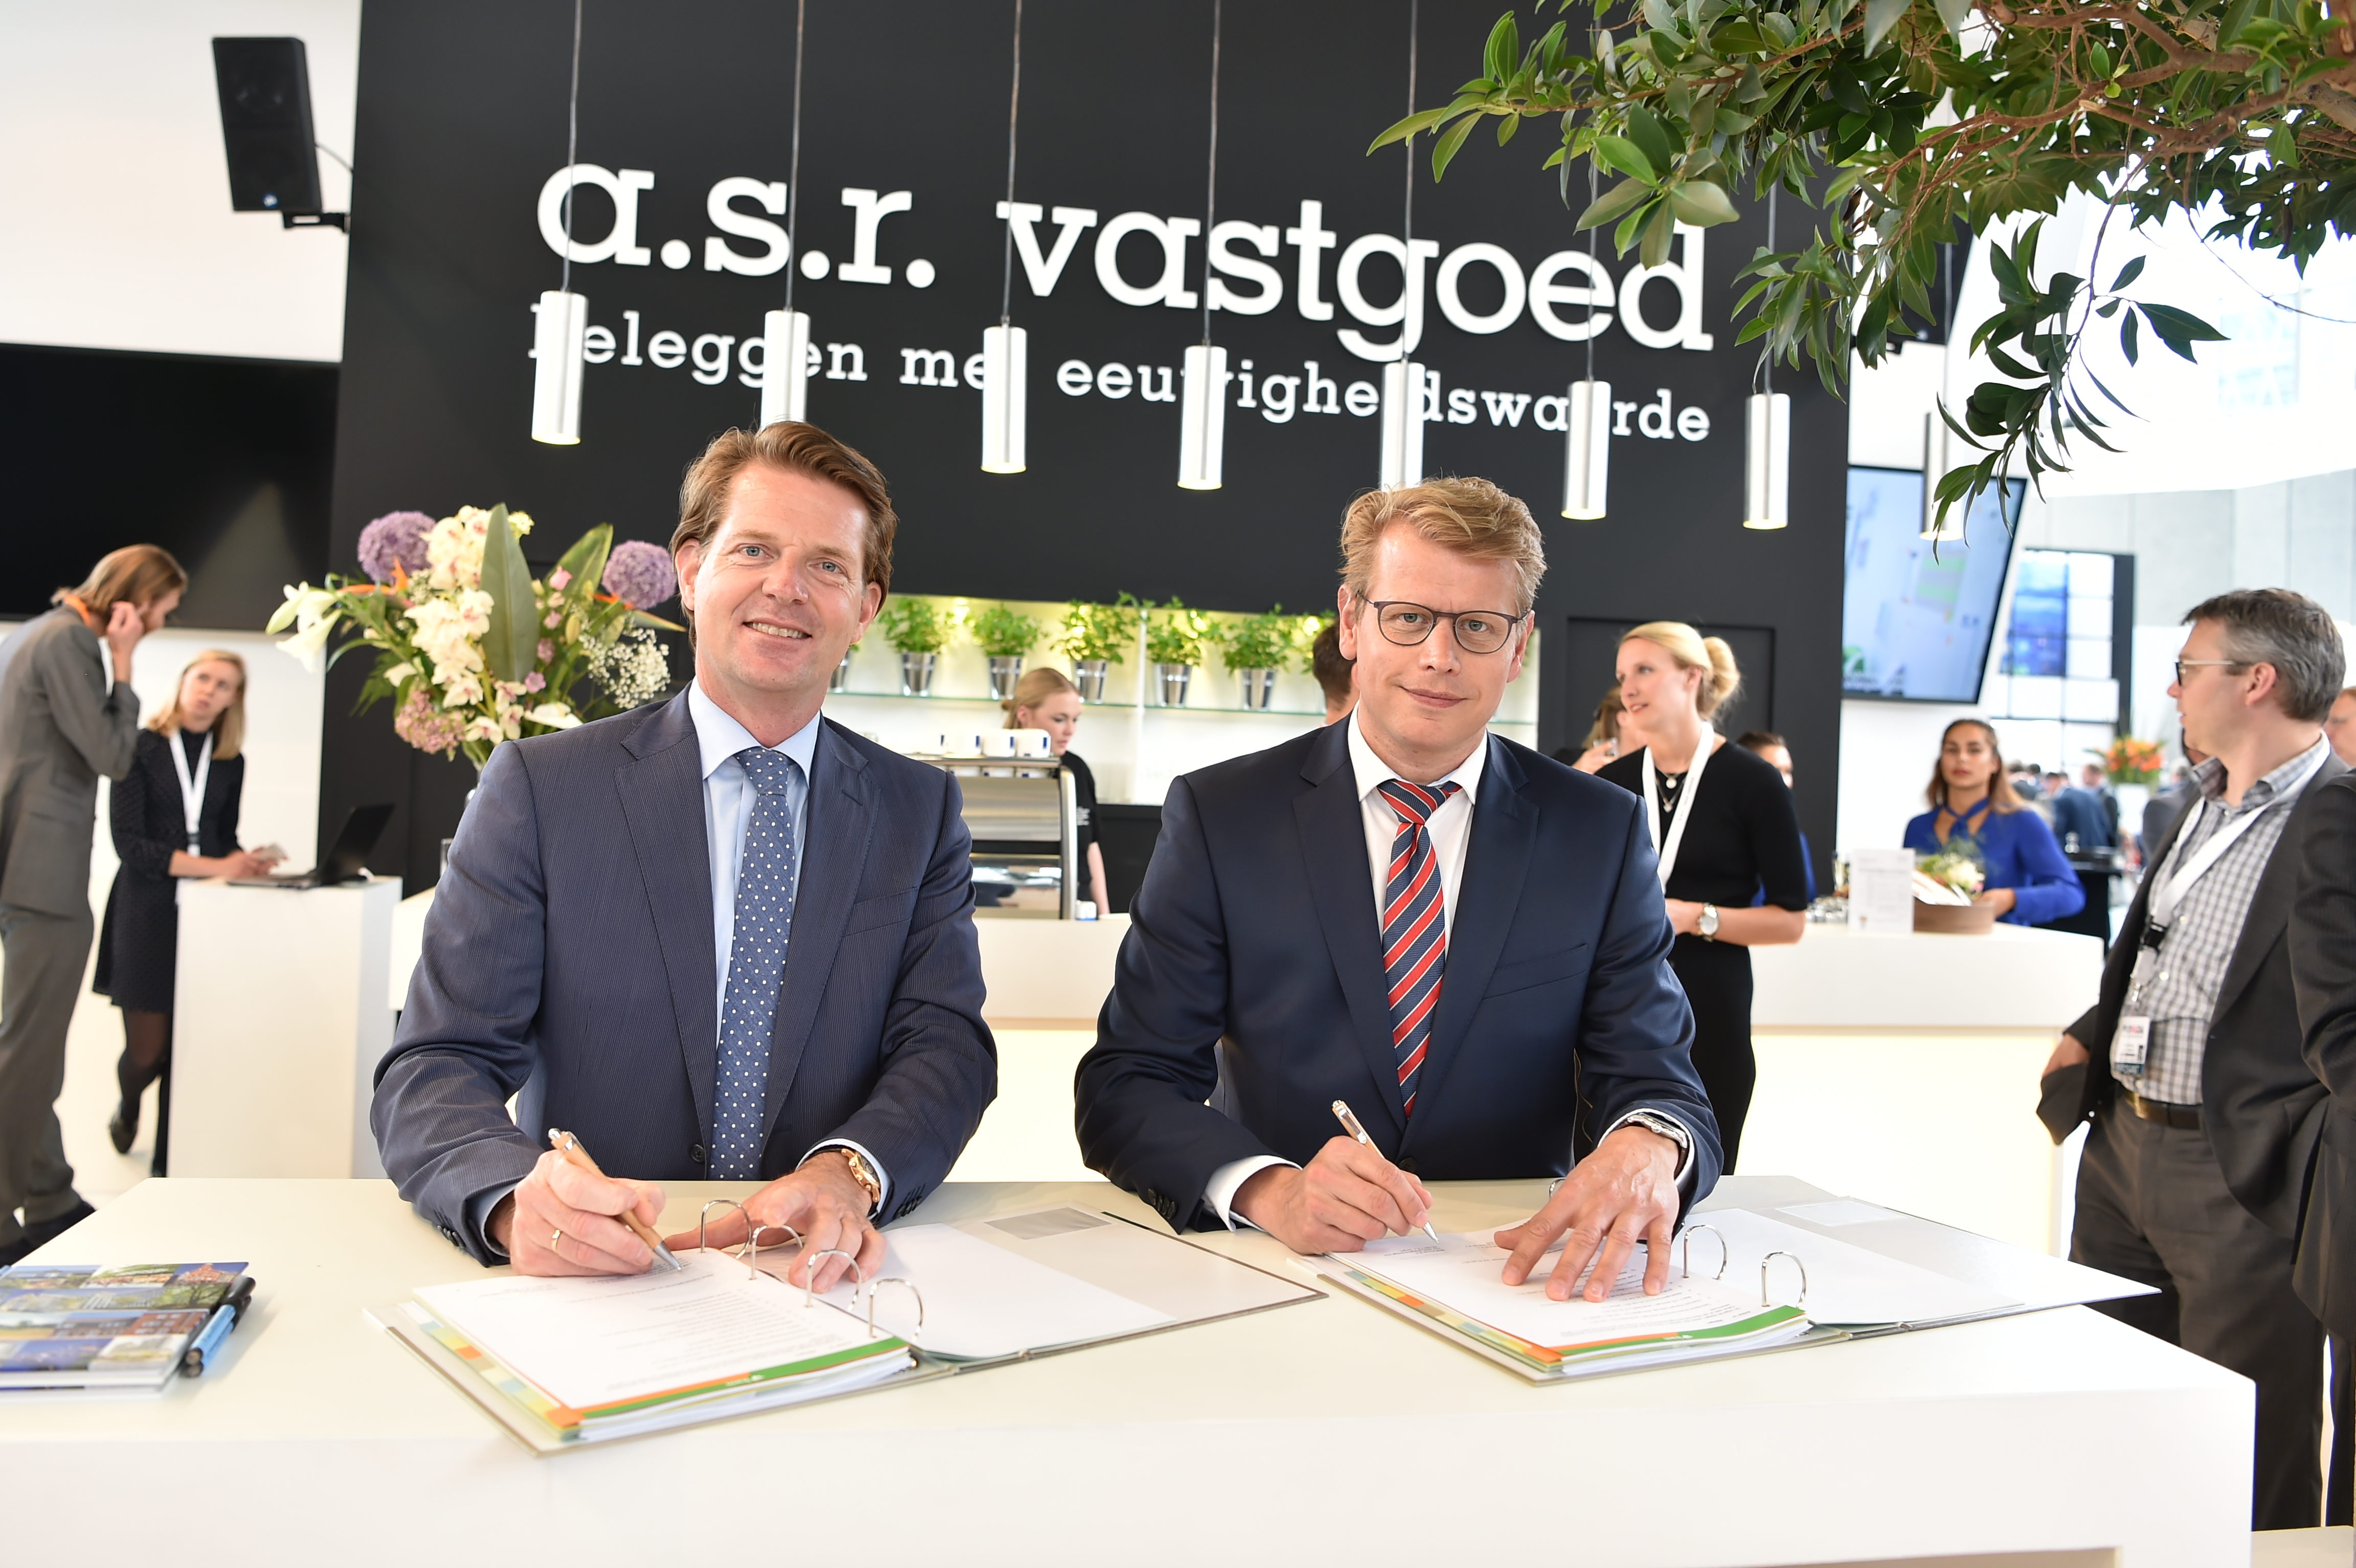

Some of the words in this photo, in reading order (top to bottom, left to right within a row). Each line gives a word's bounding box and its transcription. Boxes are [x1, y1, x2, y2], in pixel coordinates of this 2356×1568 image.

[537, 163, 935, 288] a.s.r.
[996, 200, 1714, 362] vastgoed
[528, 303, 868, 388] eleggn
[899, 347, 987, 391] me
[1057, 359, 1710, 442] eeuighedswarde
